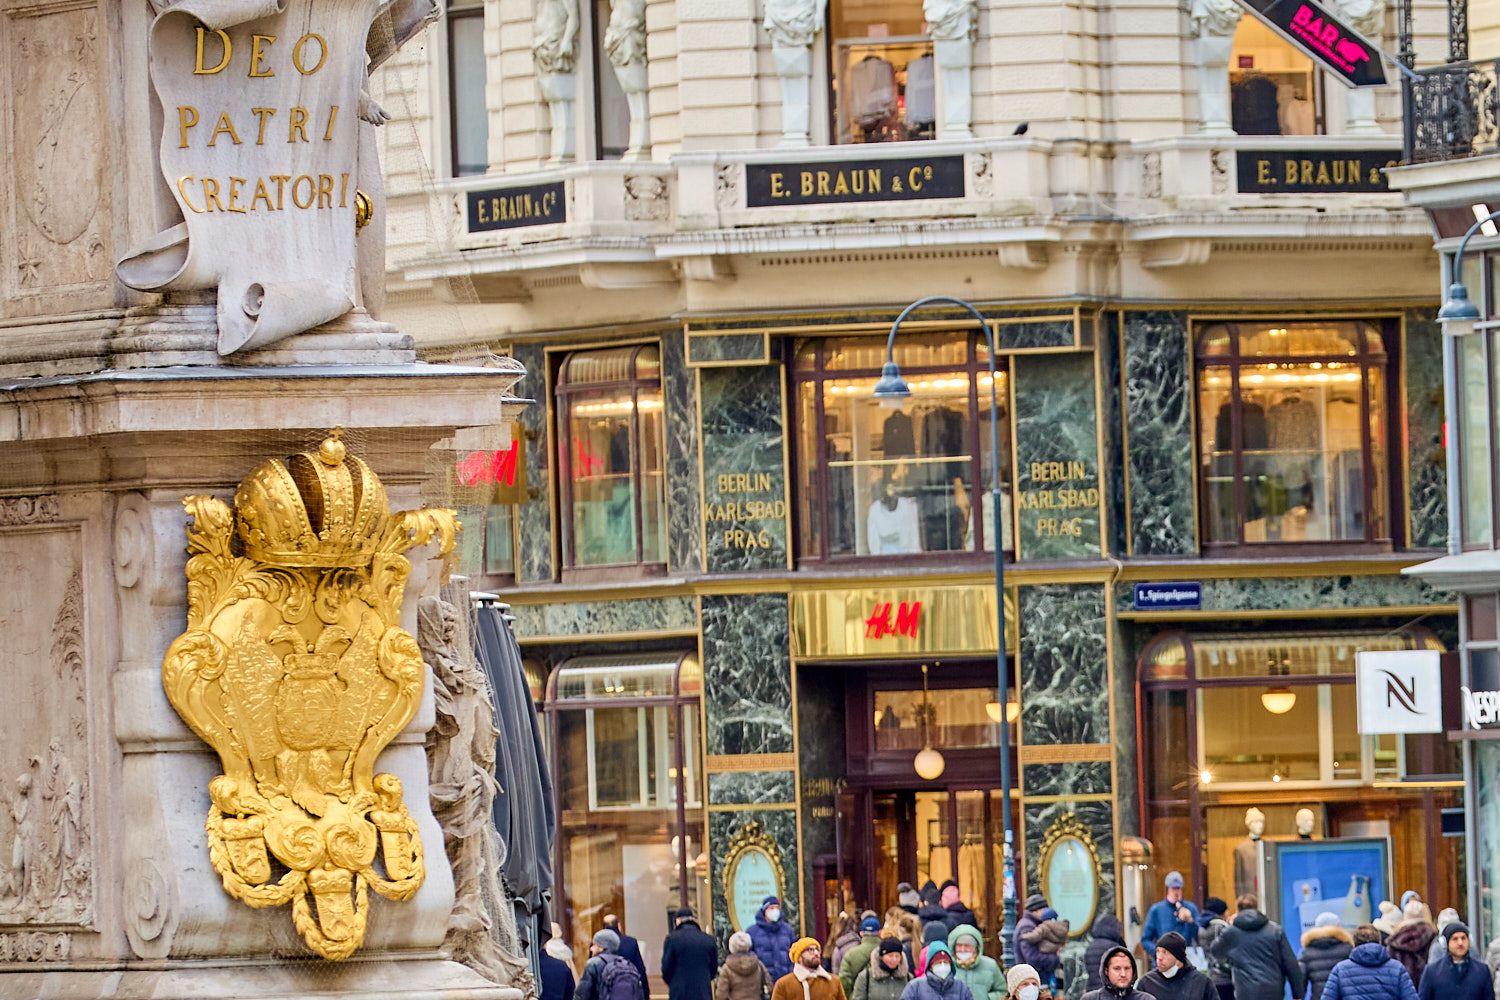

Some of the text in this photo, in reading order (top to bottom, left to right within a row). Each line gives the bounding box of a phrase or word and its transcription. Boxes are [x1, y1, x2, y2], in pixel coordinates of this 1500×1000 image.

[1291, 4, 1339, 47] BAR
[193, 27, 328, 77] DEO
[177, 105, 339, 149] PATRI
[770, 172, 791, 198] E.
[800, 168, 881, 197] BRAUN
[891, 175, 903, 193] &
[1257, 159, 1380, 186] E. BRAUN &
[177, 172, 350, 214] CREATORI
[478, 199, 490, 224] E.
[492, 193, 532, 222] BRAUN
[718, 472, 771, 494] BERLIN
[1031, 460, 1086, 481] BERLIN
[705, 500, 786, 521] KARLSBAD
[1018, 488, 1099, 510] KARLSBAD
[724, 528, 770, 550] PRAG
[1037, 517, 1083, 538] PRAG
[864, 600, 922, 639] H&M
